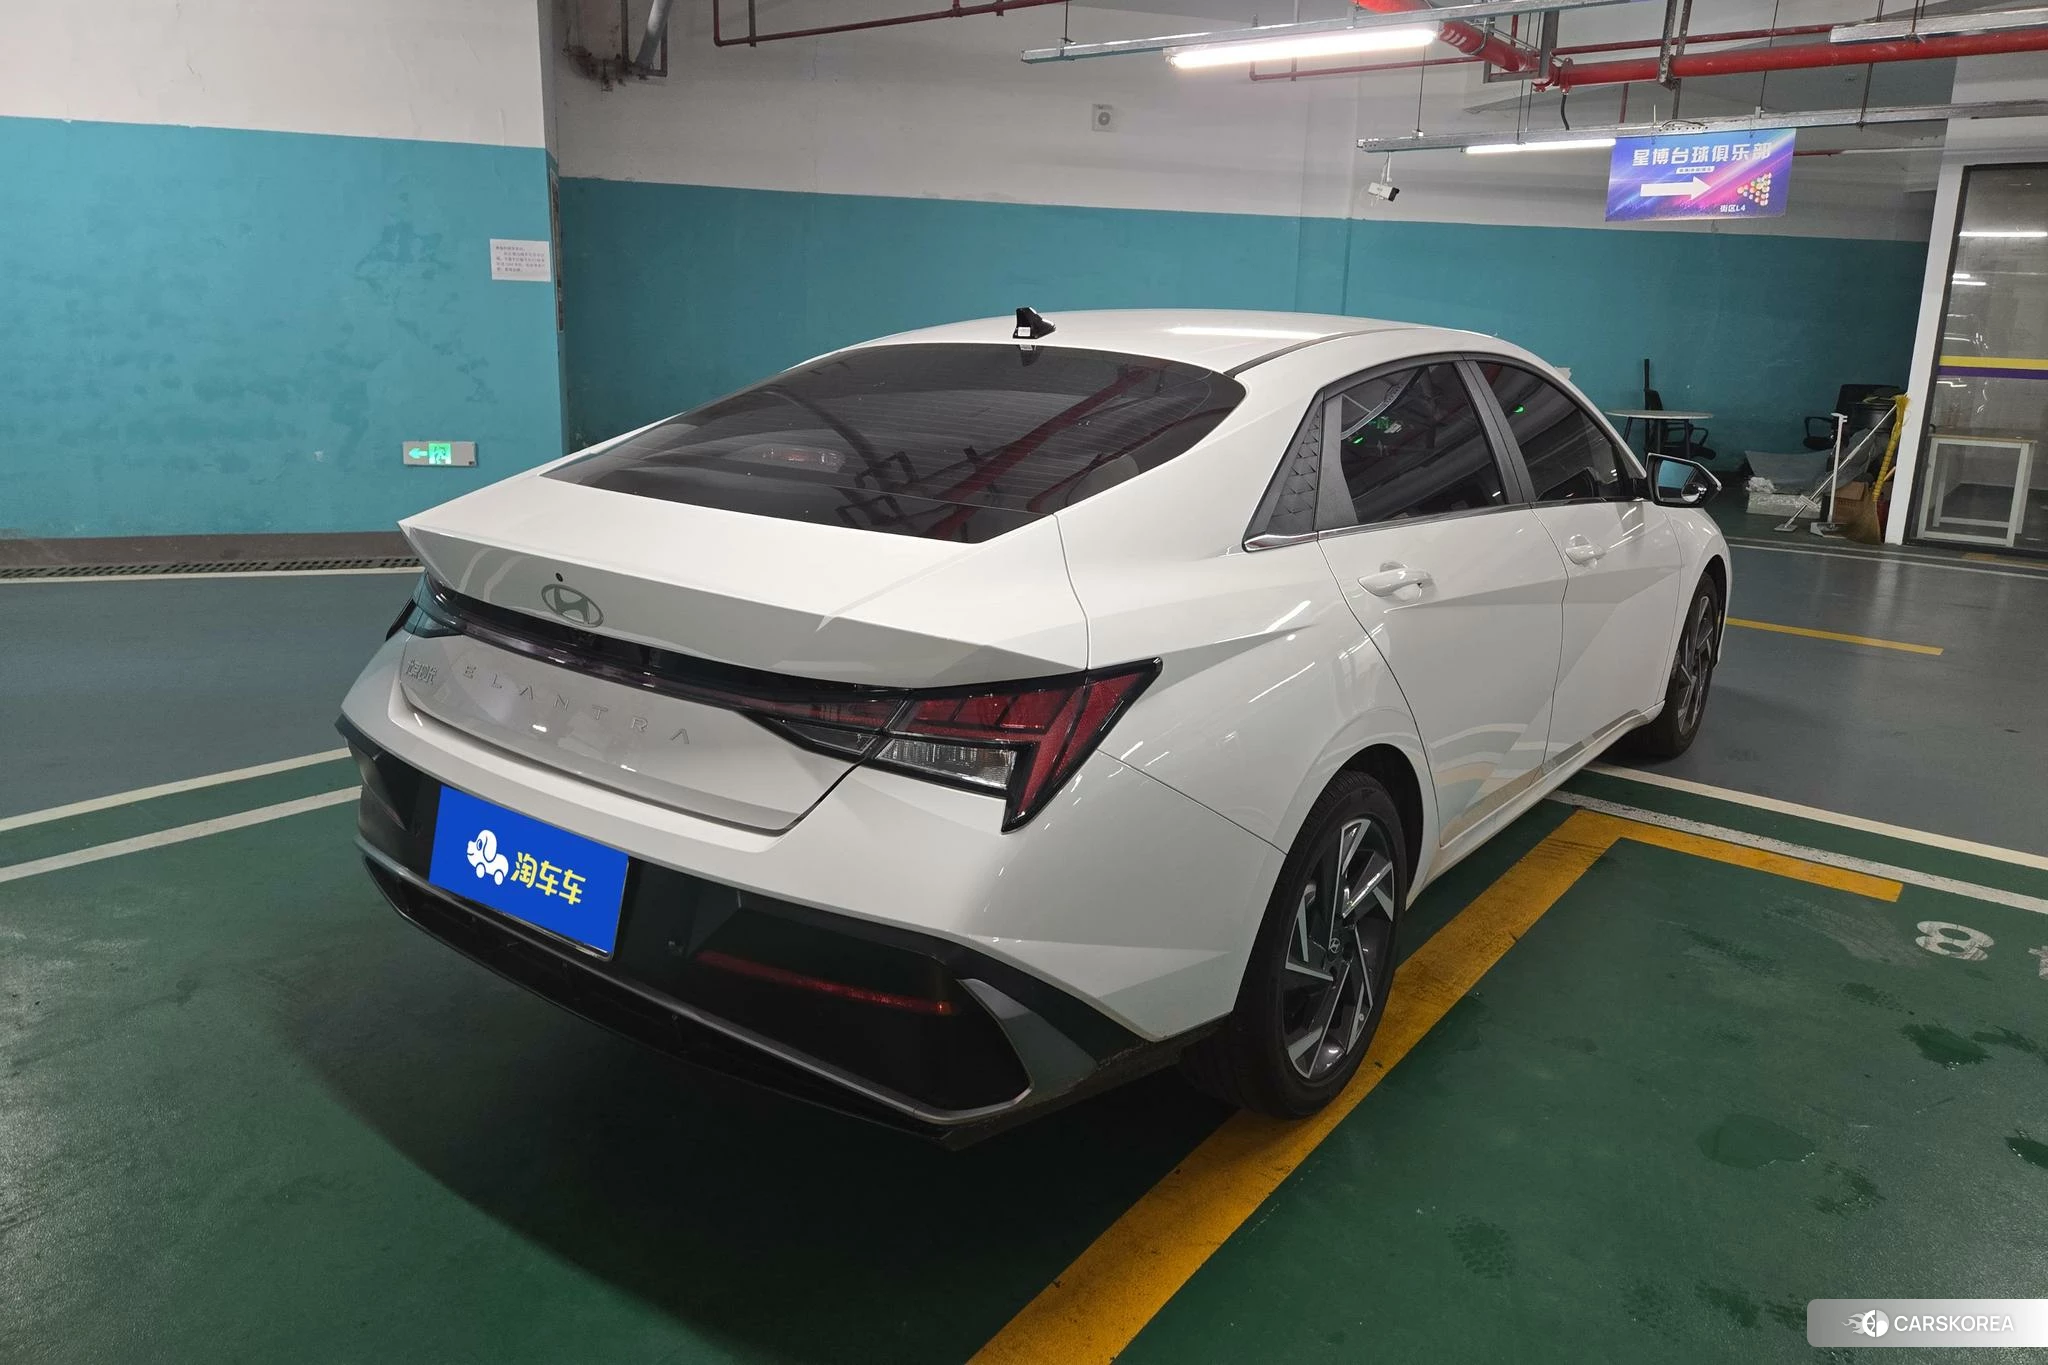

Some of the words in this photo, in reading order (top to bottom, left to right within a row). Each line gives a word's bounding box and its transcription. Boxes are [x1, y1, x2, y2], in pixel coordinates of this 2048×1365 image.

[1632, 142, 1773, 167] 星博台球俱乐部
[463, 664, 691, 745] ELANTRA
